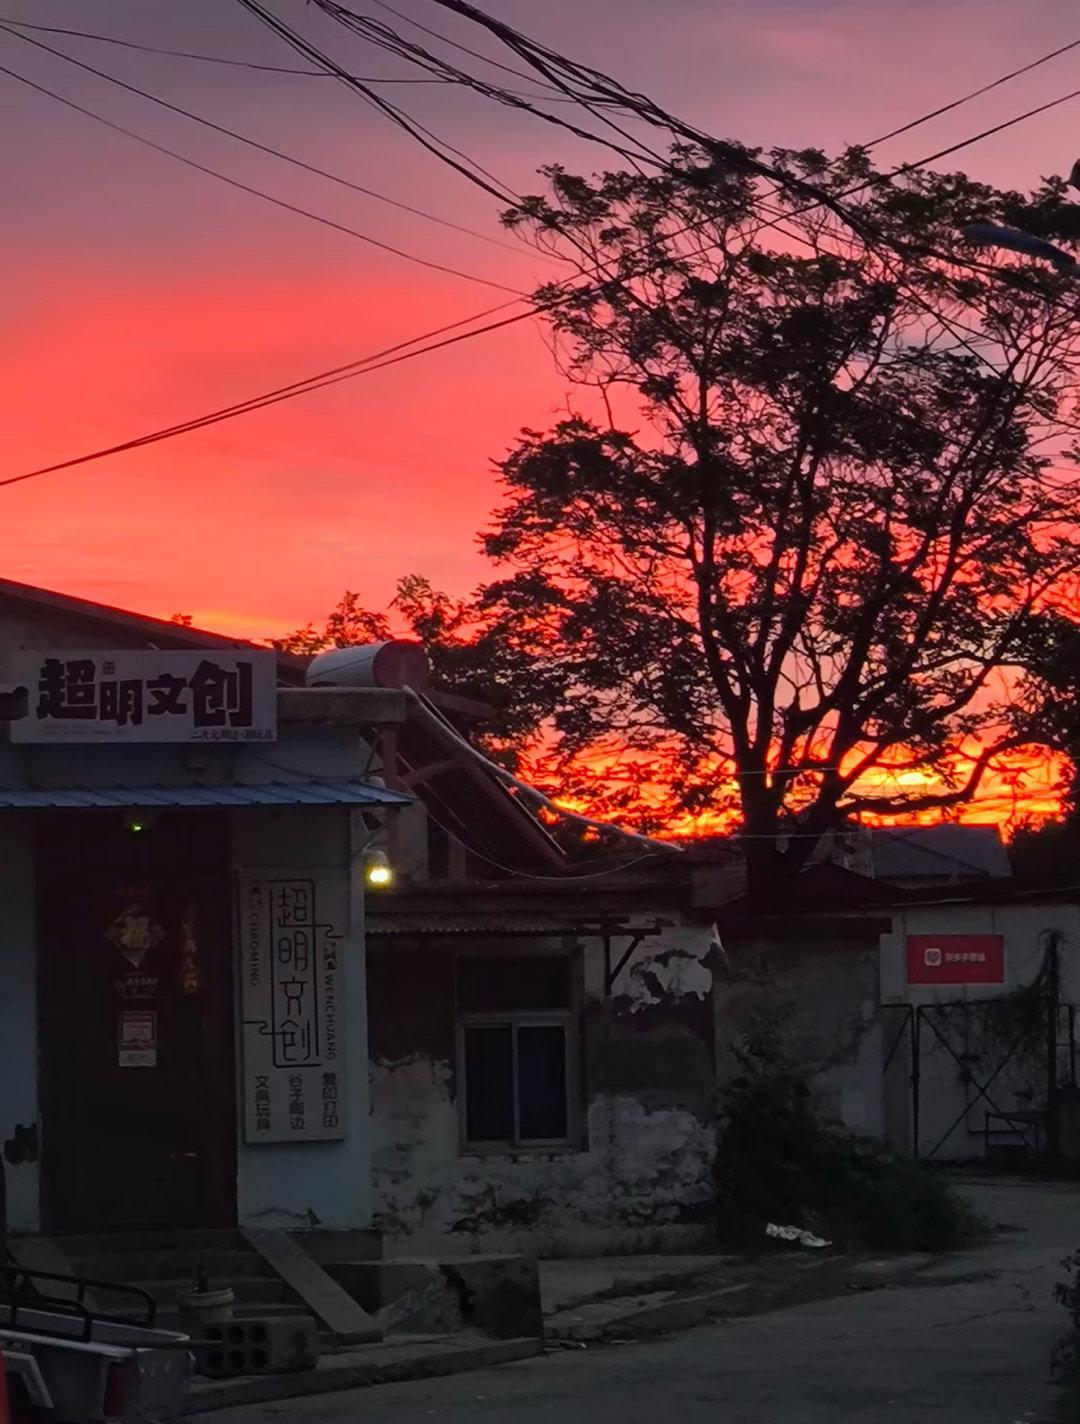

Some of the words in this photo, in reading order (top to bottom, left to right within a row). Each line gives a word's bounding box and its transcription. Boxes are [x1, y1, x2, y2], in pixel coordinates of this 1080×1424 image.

[37, 658, 252, 727] 超明文创
[278, 886, 310, 1061] 超明文创
[324, 974, 336, 1061] WENCHUANG
